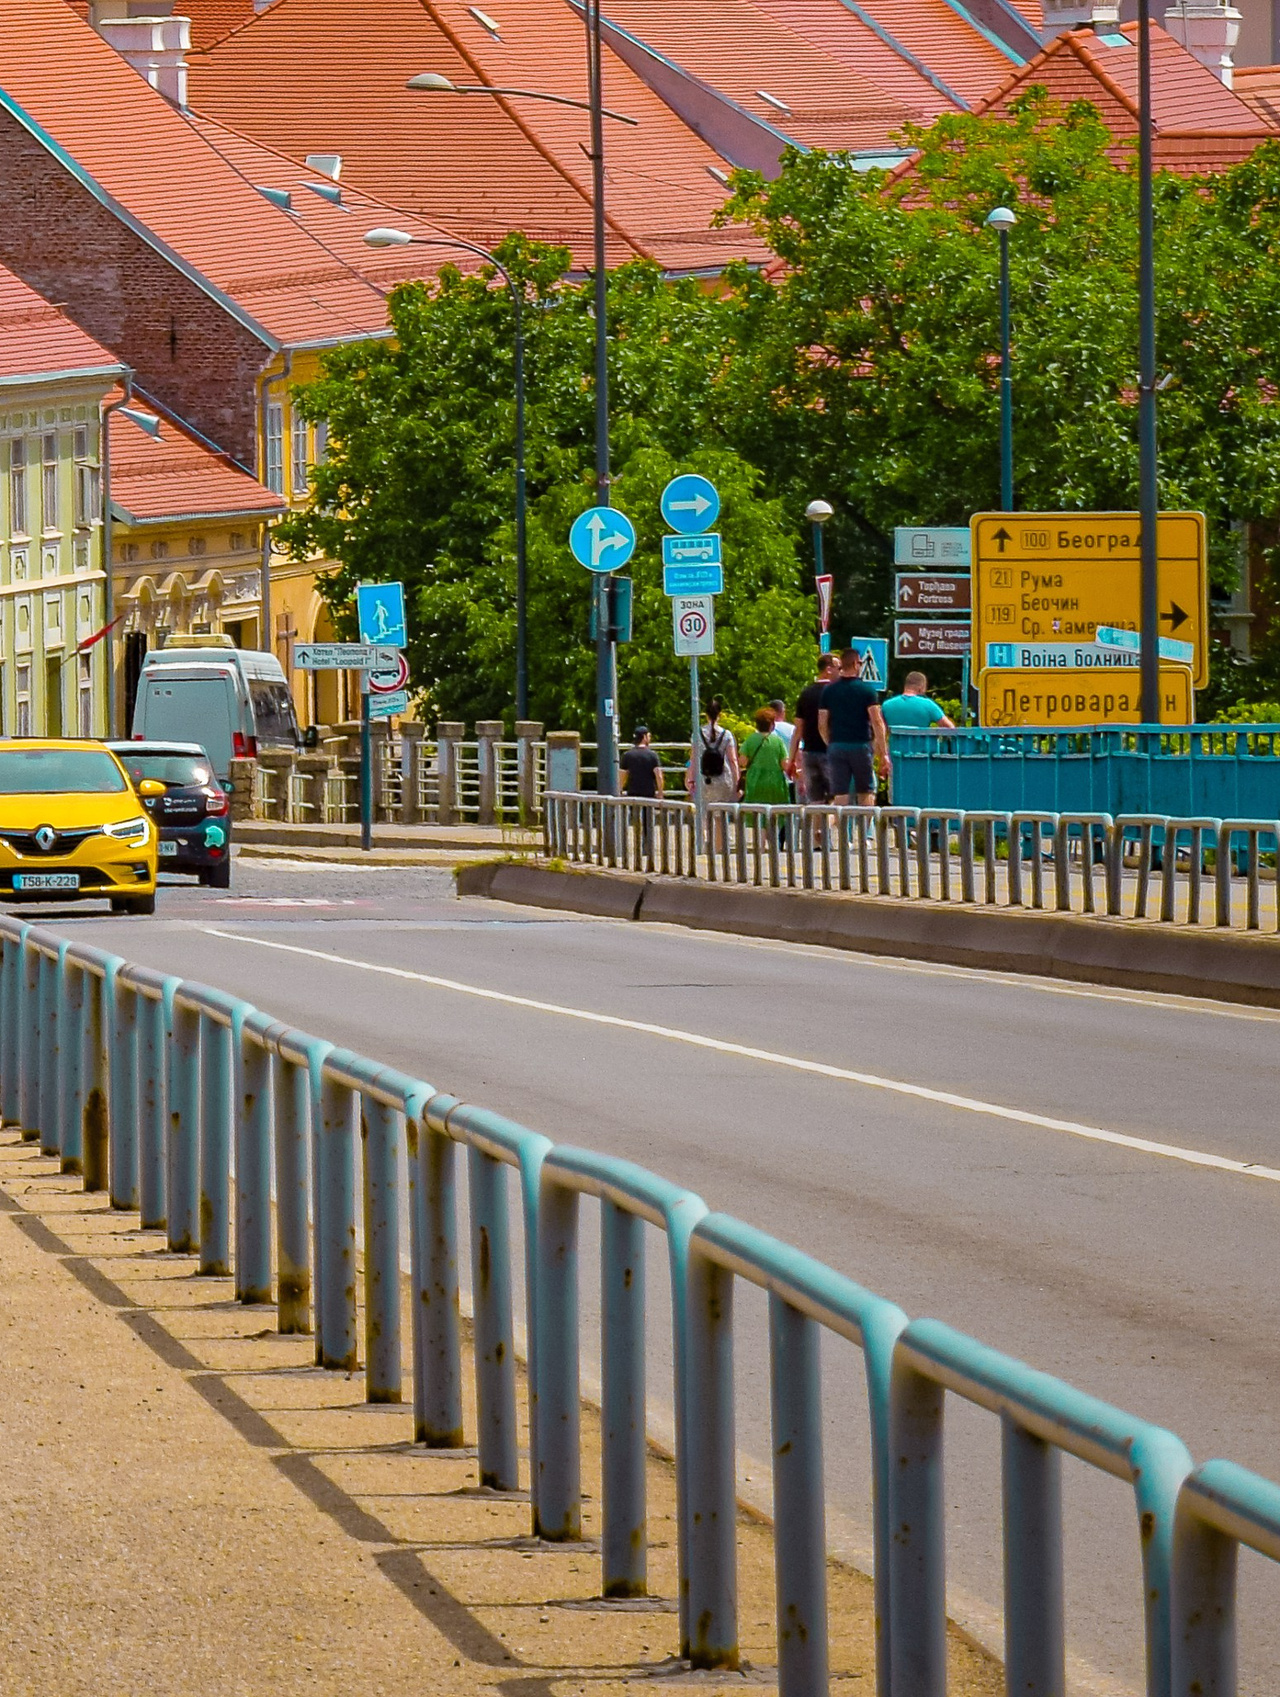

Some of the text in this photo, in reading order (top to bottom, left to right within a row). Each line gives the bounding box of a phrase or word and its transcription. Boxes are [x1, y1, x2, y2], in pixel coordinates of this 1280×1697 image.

[1024, 532, 1047, 548] 100
[994, 571, 1008, 585] 21
[1020, 570, 1063, 592] Рума
[680, 600, 704, 610] ЗОНА
[917, 593, 954, 604] Fortress
[1021, 594, 1079, 611] Беочин
[991, 607, 1010, 621] 119
[684, 618, 702, 633] 30
[1021, 617, 1045, 639] Ср.
[918, 640, 935, 651] City
[1003, 689, 1176, 718] Петроварадн
